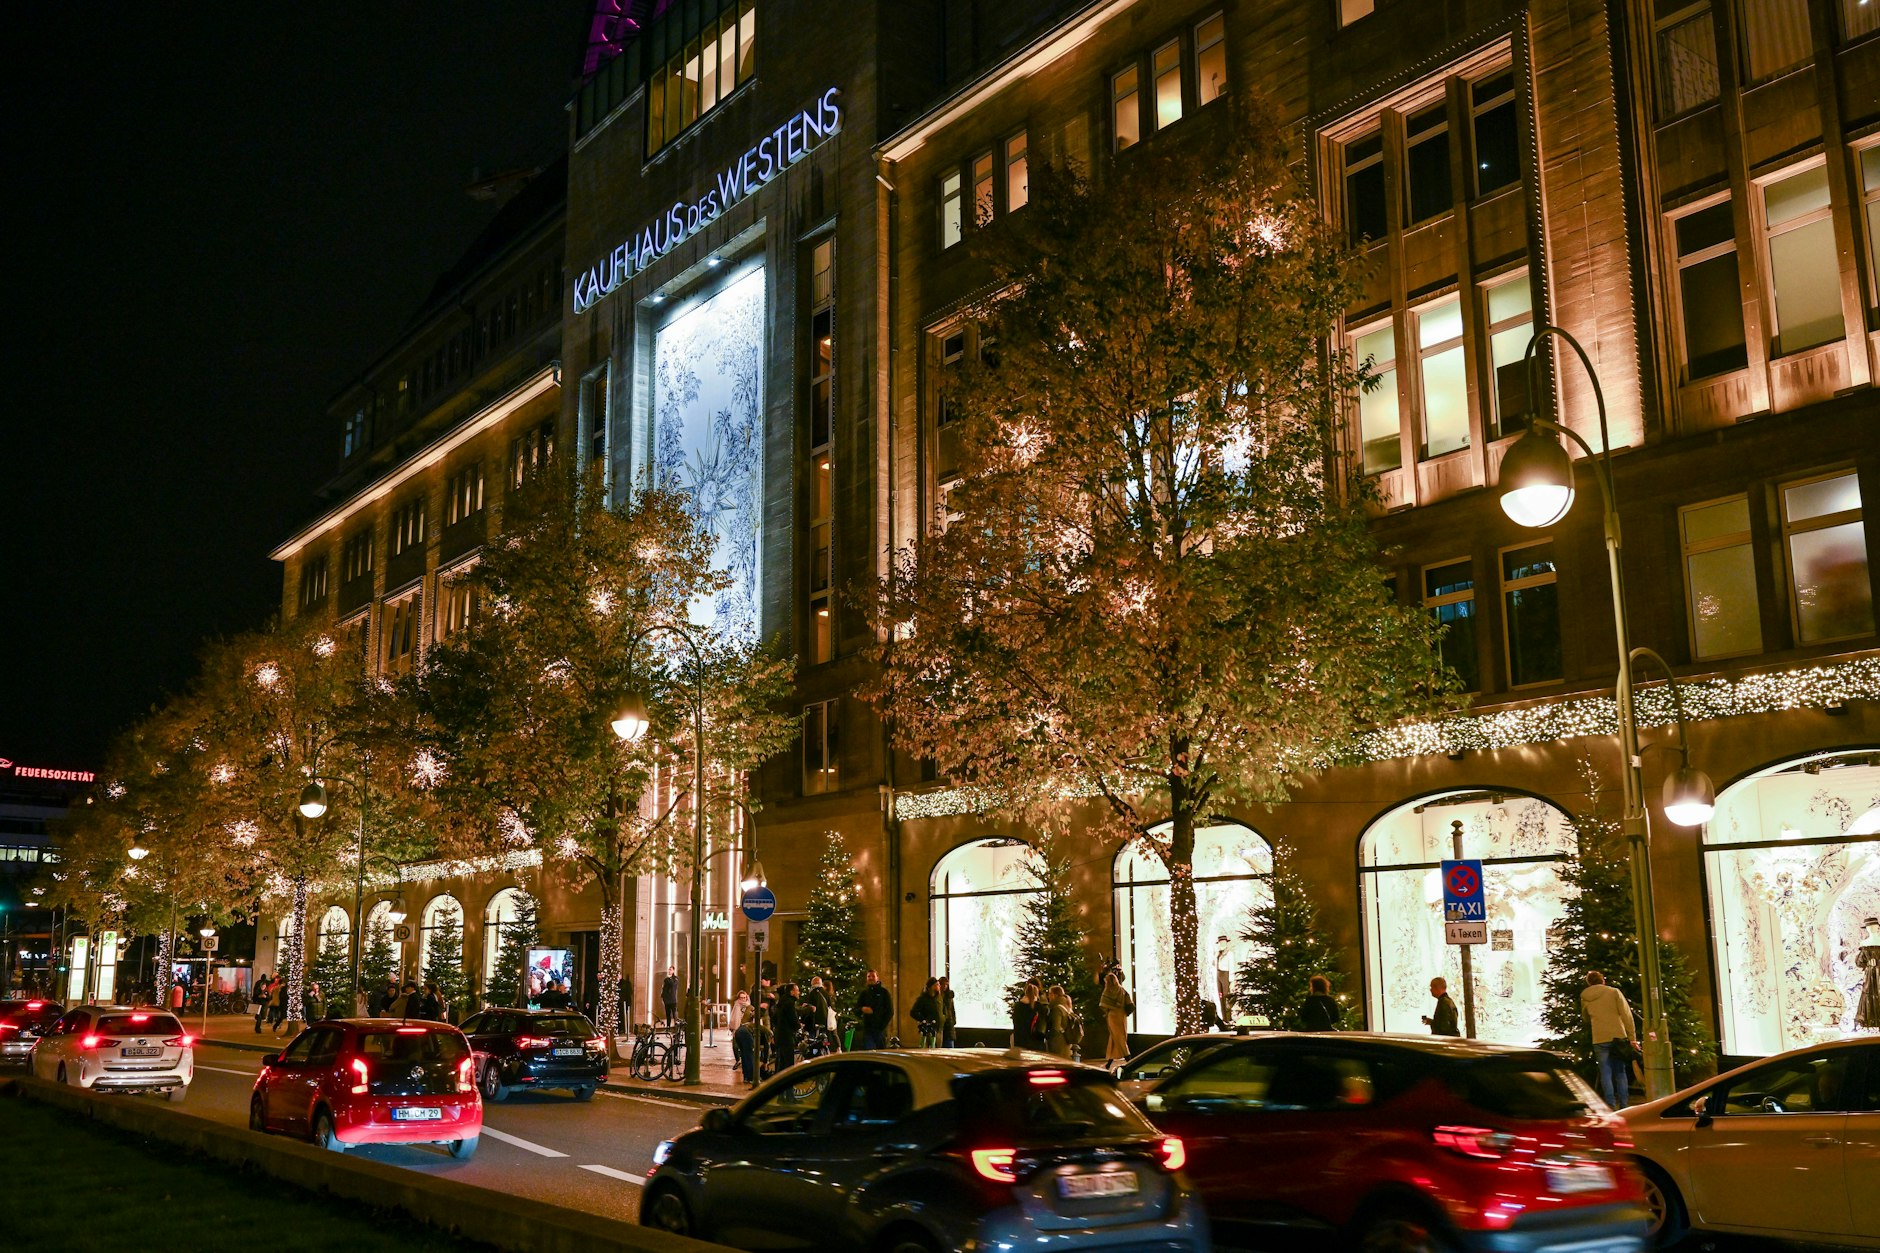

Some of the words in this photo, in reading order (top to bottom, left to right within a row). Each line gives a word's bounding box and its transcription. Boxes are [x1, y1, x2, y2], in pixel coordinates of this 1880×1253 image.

[573, 201, 686, 313] KAUFHAUS
[687, 189, 718, 234] DES
[717, 87, 843, 208] WESTENS
[15, 766, 95, 782] FEUERSOZIETÄT
[1448, 902, 1482, 916] TAXI
[1450, 929, 1456, 938] 4
[1458, 928, 1483, 938] Taxen
[398, 1110, 410, 1118] HM
[428, 1109, 439, 1118] 29
